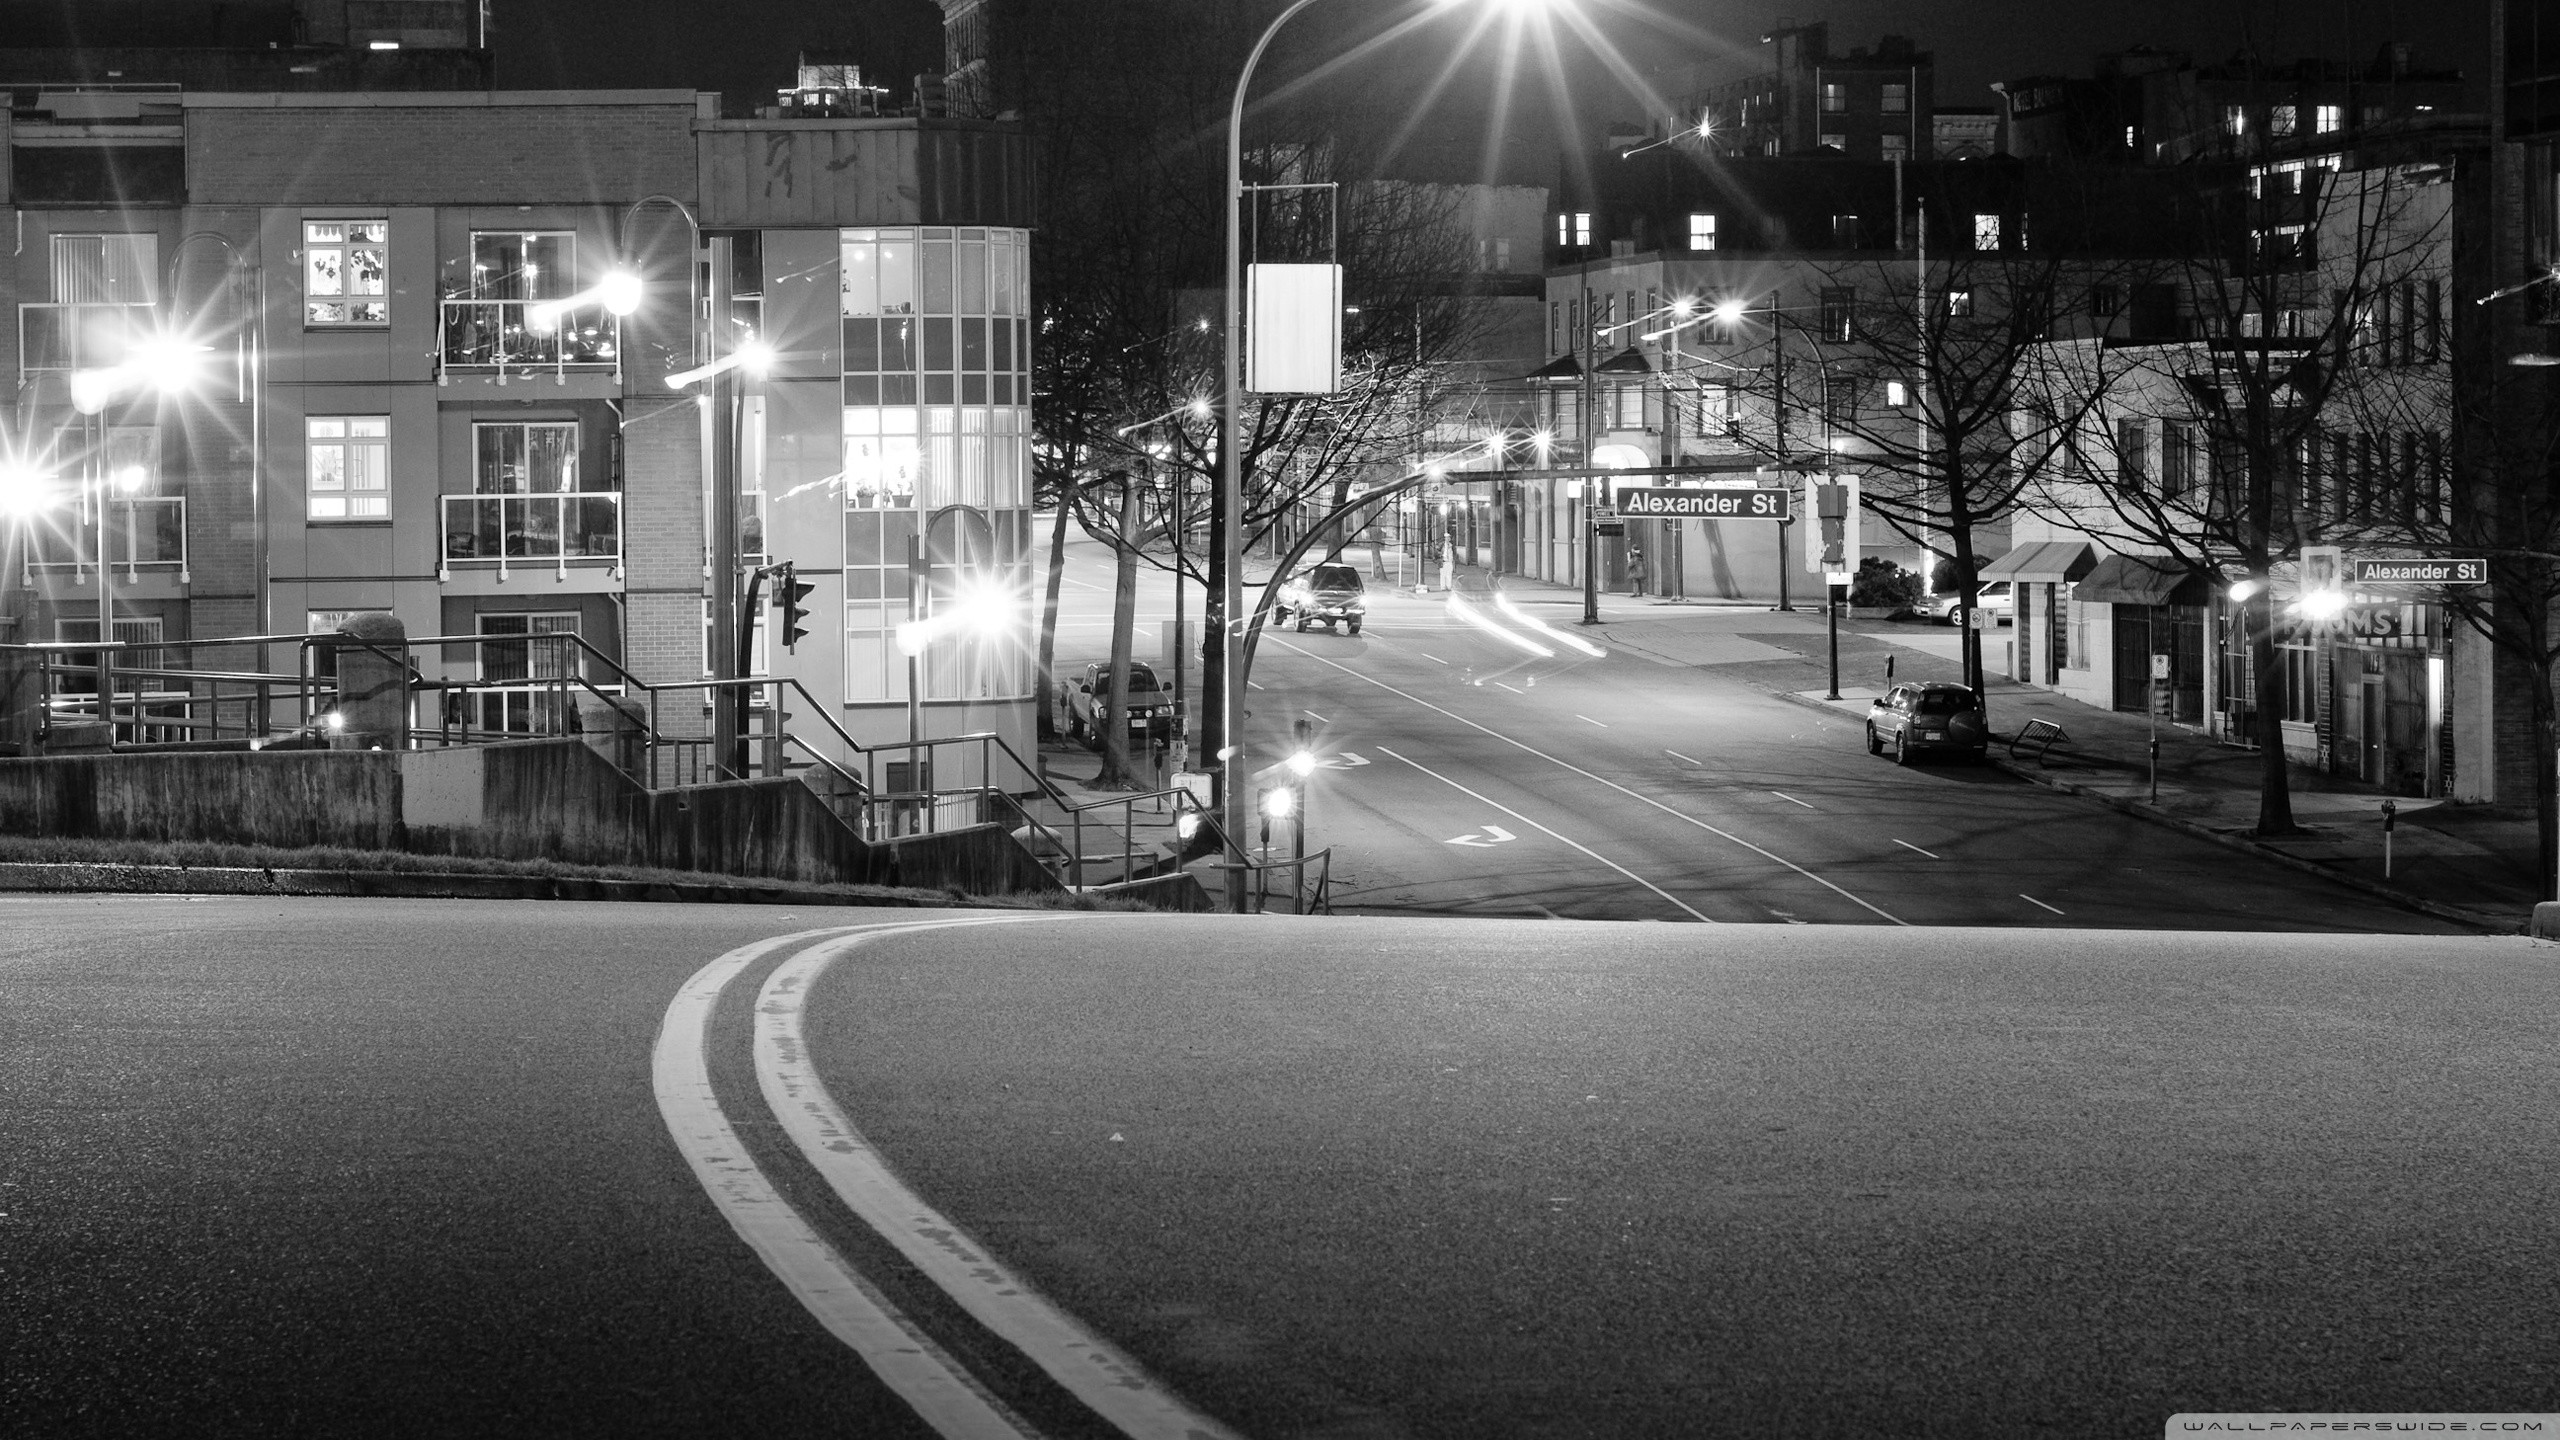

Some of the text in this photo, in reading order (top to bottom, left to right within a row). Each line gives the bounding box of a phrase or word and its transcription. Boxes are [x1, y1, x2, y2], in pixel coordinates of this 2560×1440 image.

[1627, 492, 1778, 515] Alexander St
[2364, 563, 2477, 580] Alexander St
[2284, 608, 2392, 635] ROMS
